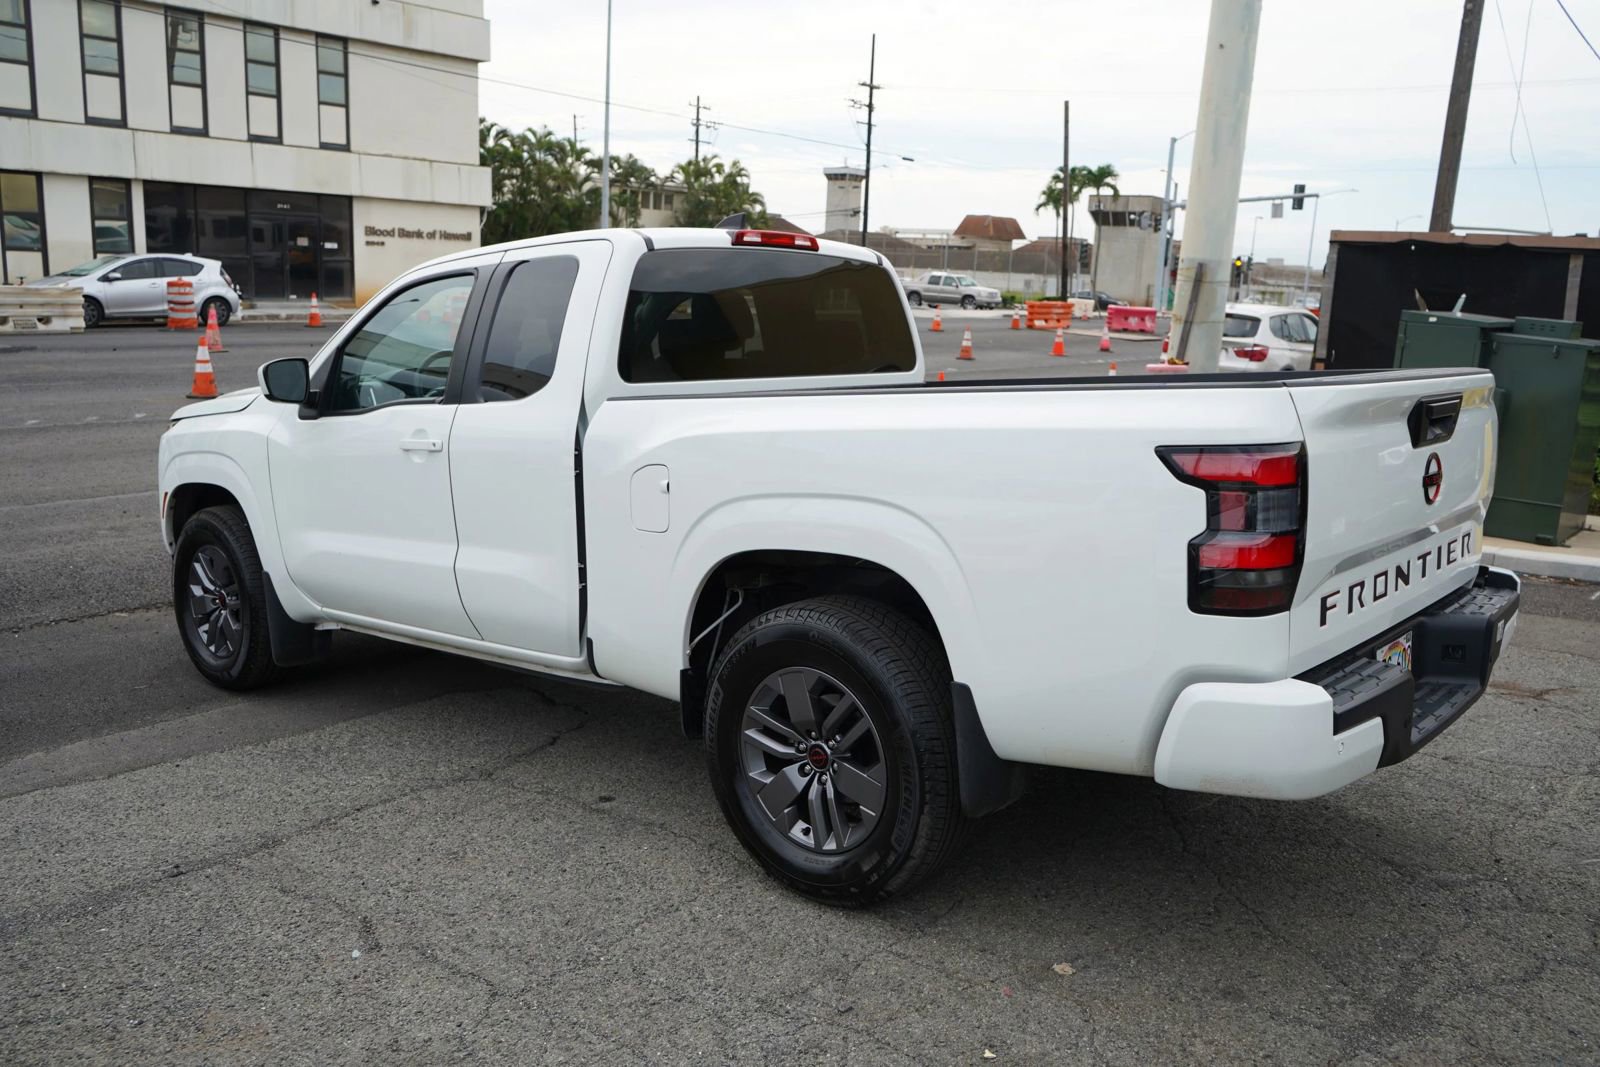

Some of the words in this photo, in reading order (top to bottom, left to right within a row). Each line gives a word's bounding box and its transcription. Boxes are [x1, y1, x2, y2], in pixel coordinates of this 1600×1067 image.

[364, 225, 395, 238] Blood
[397, 227, 424, 240] Bank
[426, 229, 437, 240] of
[1319, 531, 1473, 628] FRONTIER
